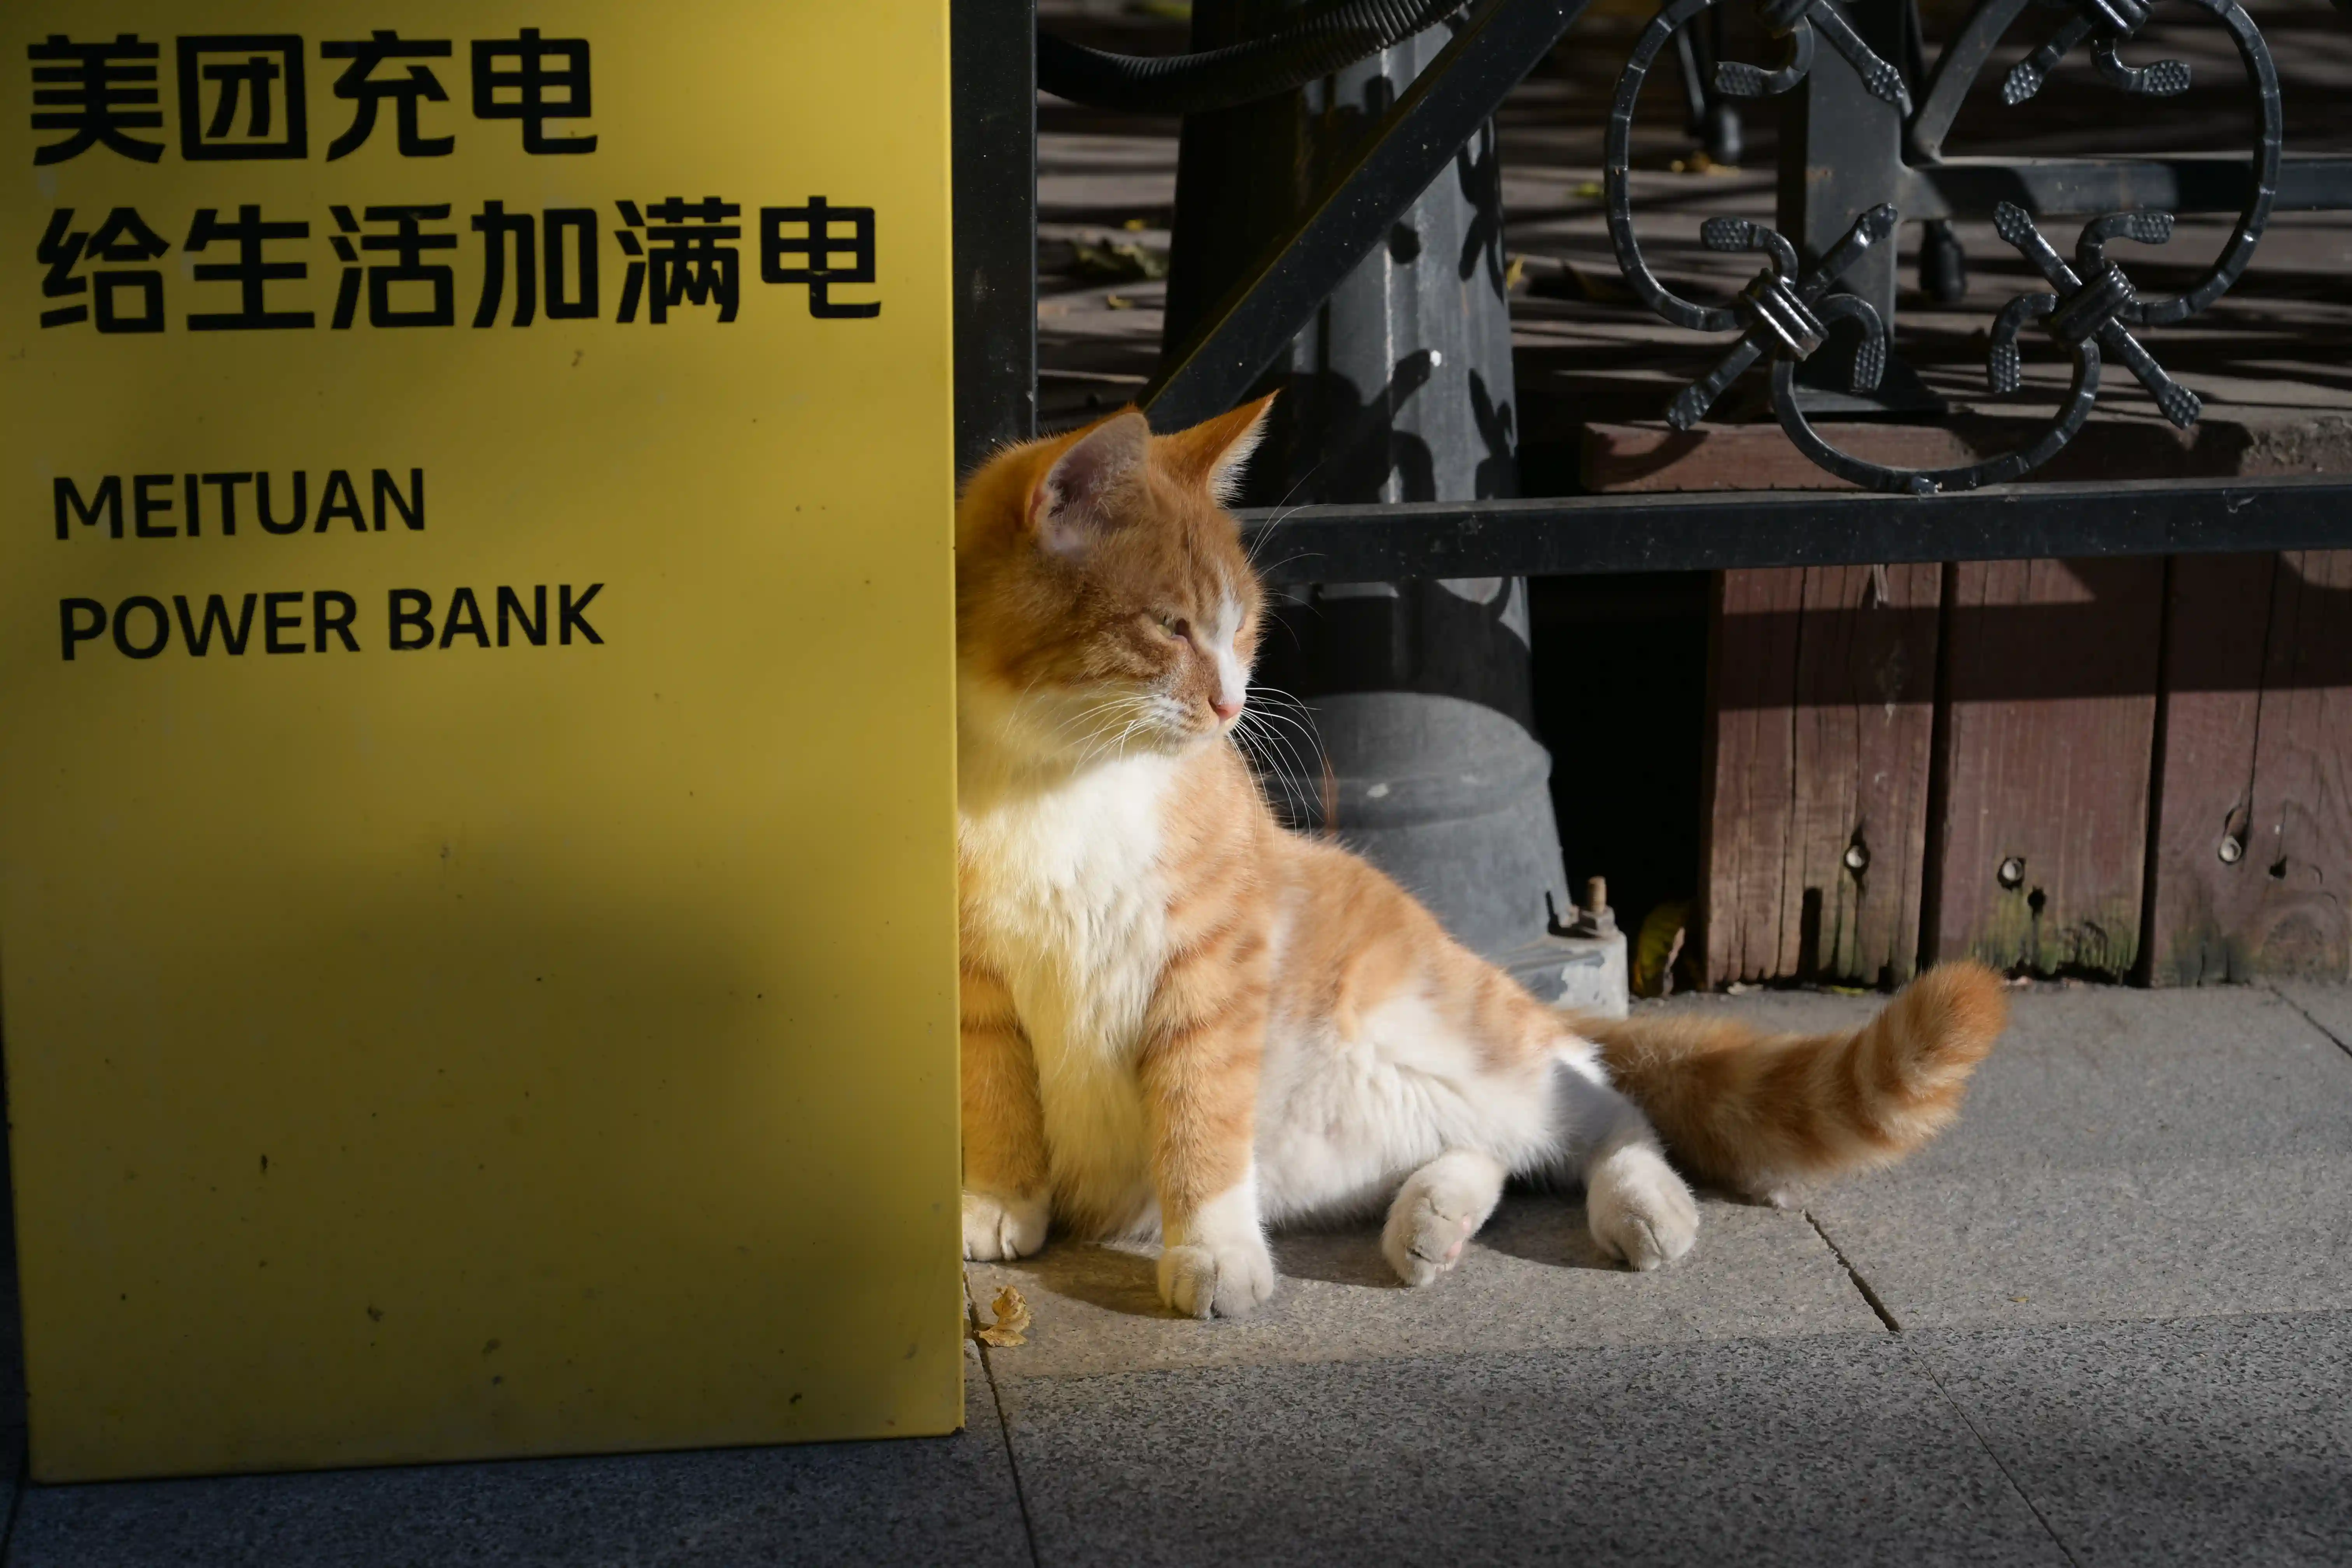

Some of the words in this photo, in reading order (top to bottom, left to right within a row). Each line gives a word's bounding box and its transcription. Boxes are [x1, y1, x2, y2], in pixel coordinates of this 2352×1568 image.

[27, 28, 598, 166] 美团充电
[37, 196, 881, 335] 给生活加满电
[53, 468, 425, 541] MEITUAN
[58, 590, 361, 662] POWER
[388, 583, 605, 651] BANK
